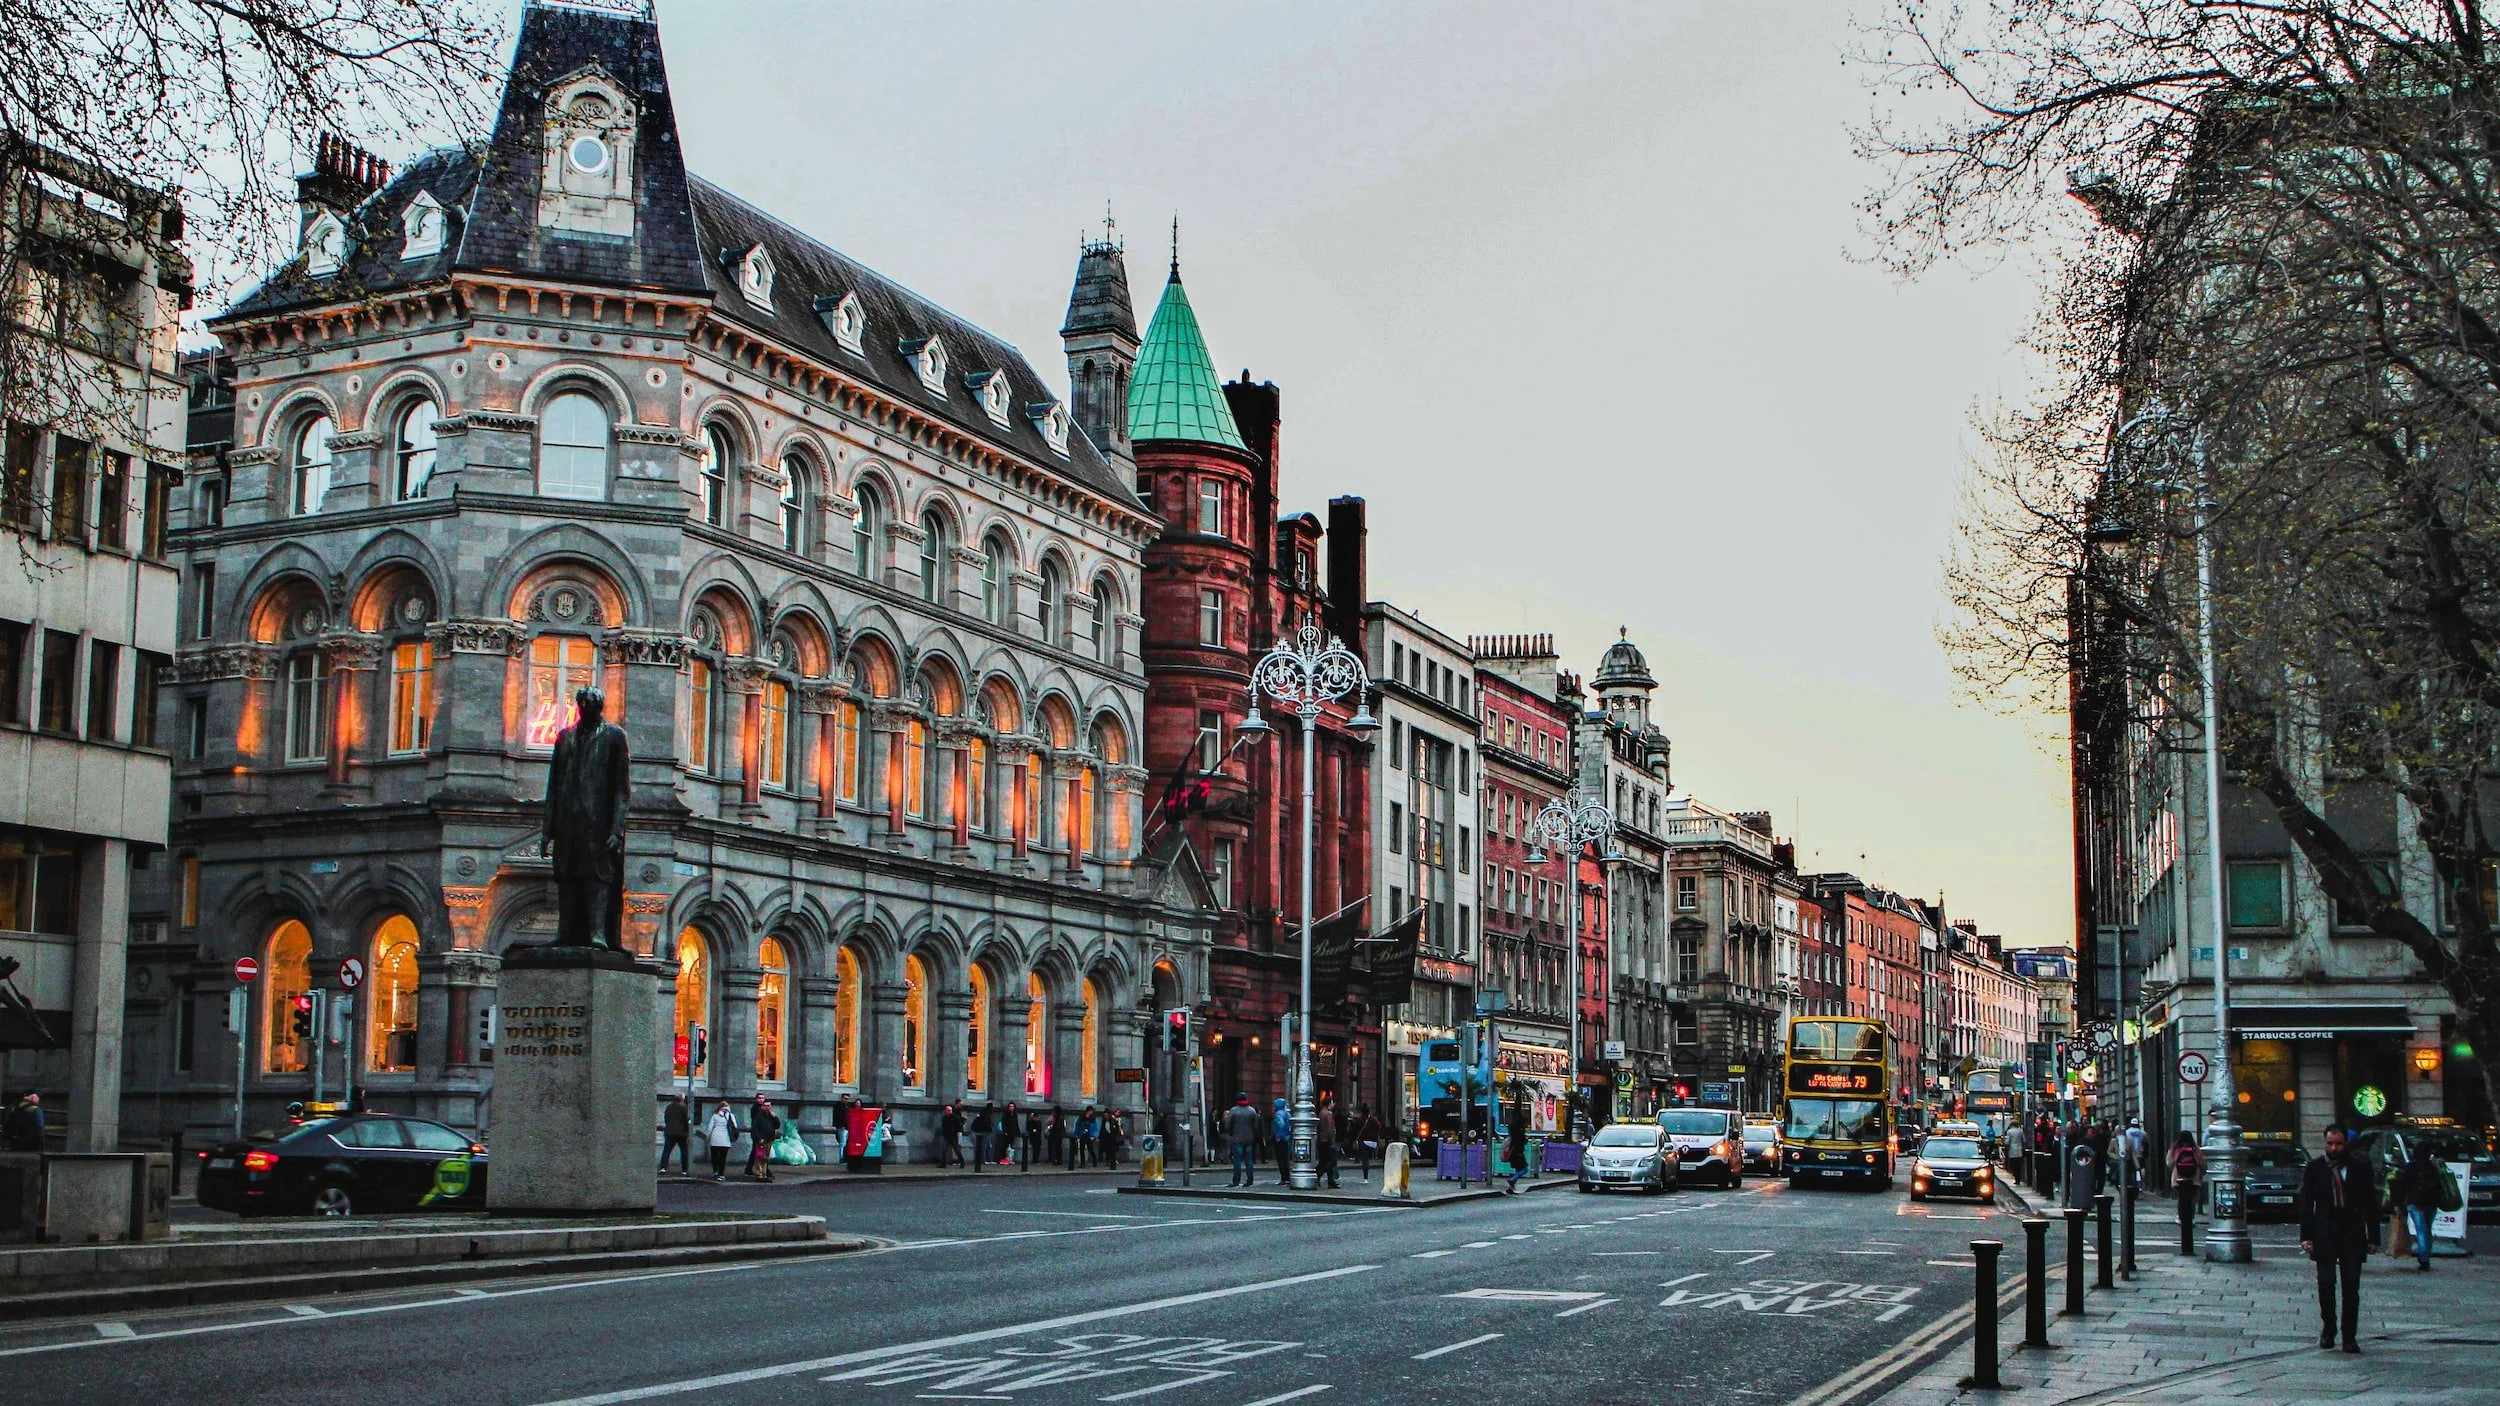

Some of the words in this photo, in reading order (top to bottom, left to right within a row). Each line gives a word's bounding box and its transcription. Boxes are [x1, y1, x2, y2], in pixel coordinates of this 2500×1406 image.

[2092, 1022, 2114, 1032] COSTA
[2241, 1032, 2296, 1040] STARBUCKS
[2068, 1042, 2088, 1051] COSTA
[2089, 1041, 2118, 1053] COFFEE
[2182, 1065, 2204, 1075] TAXI
[1854, 1076, 1867, 1088] 79
[1730, 1279, 1921, 1301] BUS
[995, 1333, 1304, 1366] BUS
